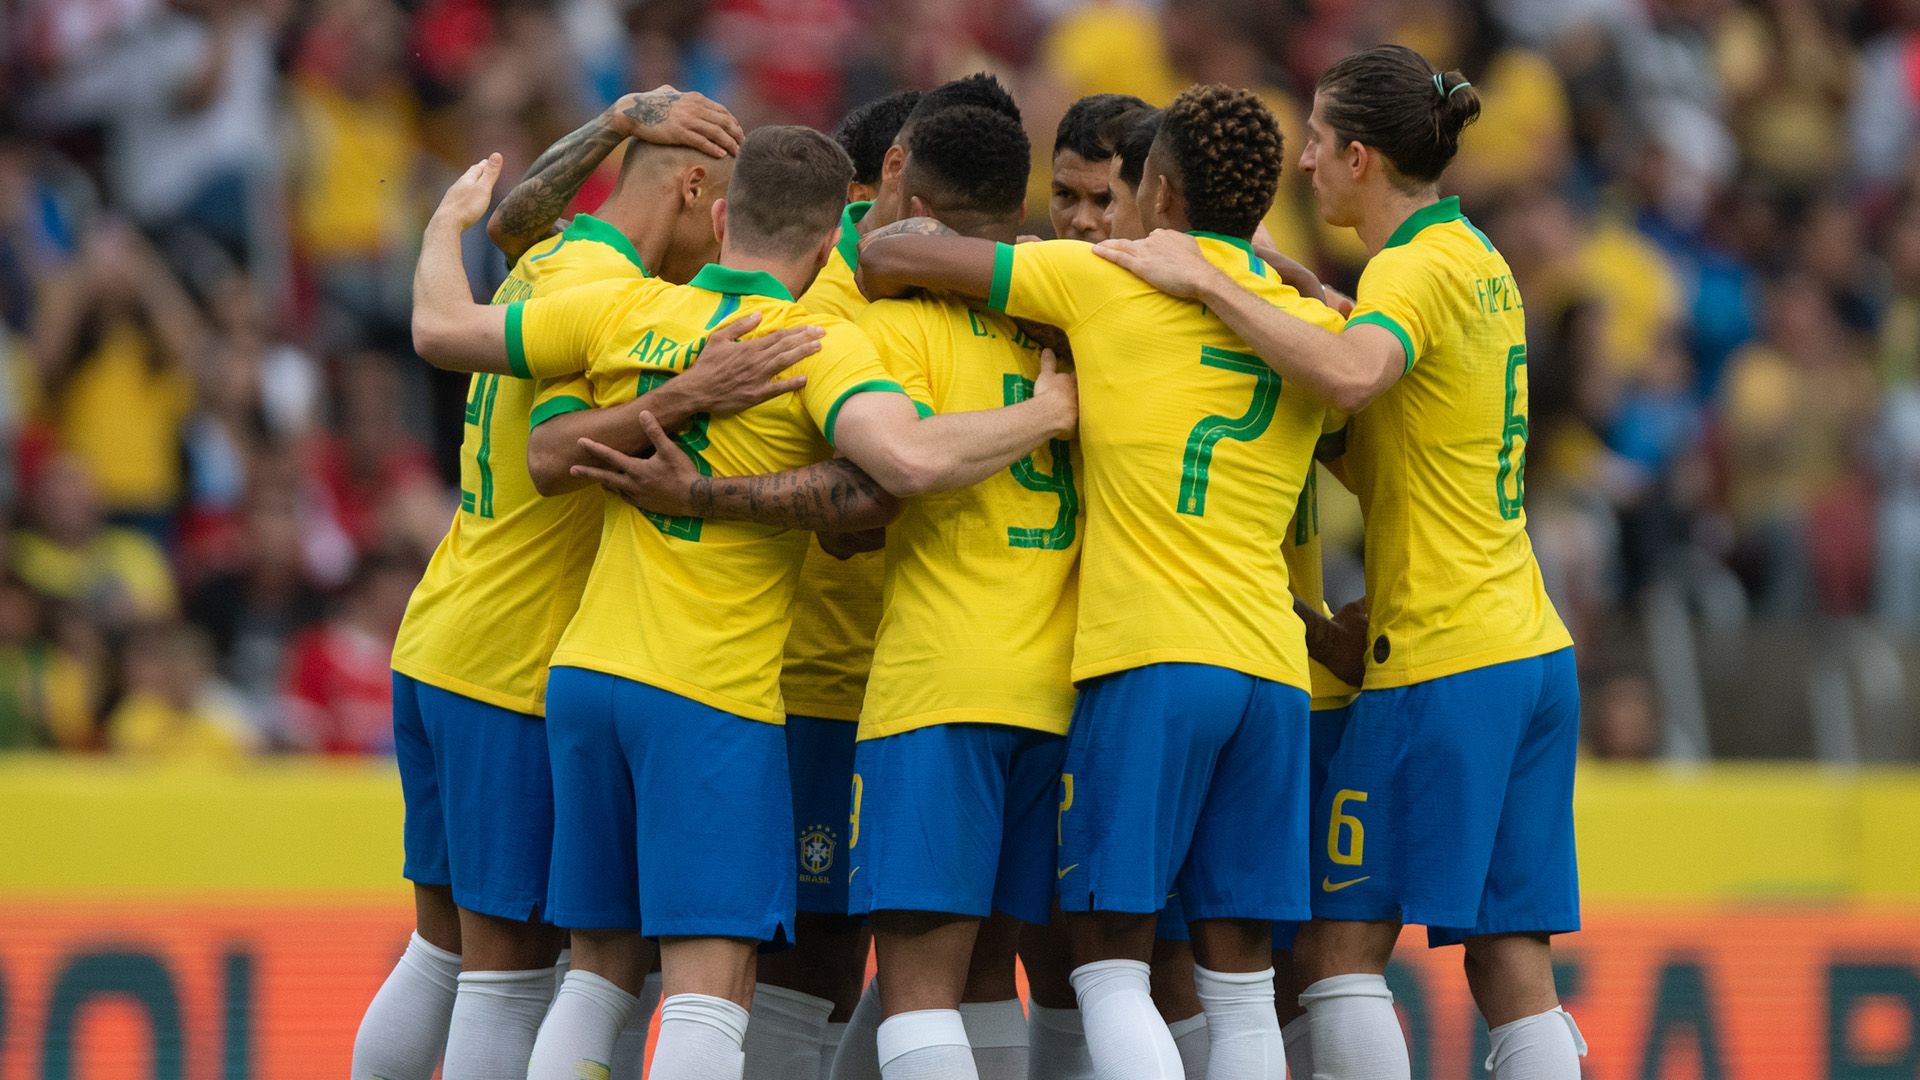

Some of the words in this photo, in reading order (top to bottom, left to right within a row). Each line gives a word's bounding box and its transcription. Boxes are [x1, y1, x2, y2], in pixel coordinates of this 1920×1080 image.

[627, 329, 706, 370] ARTH
[1176, 344, 1282, 517] 7
[1496, 344, 1529, 521] 6
[1327, 789, 1368, 867] 6
[799, 873, 831, 885] BRASIL
